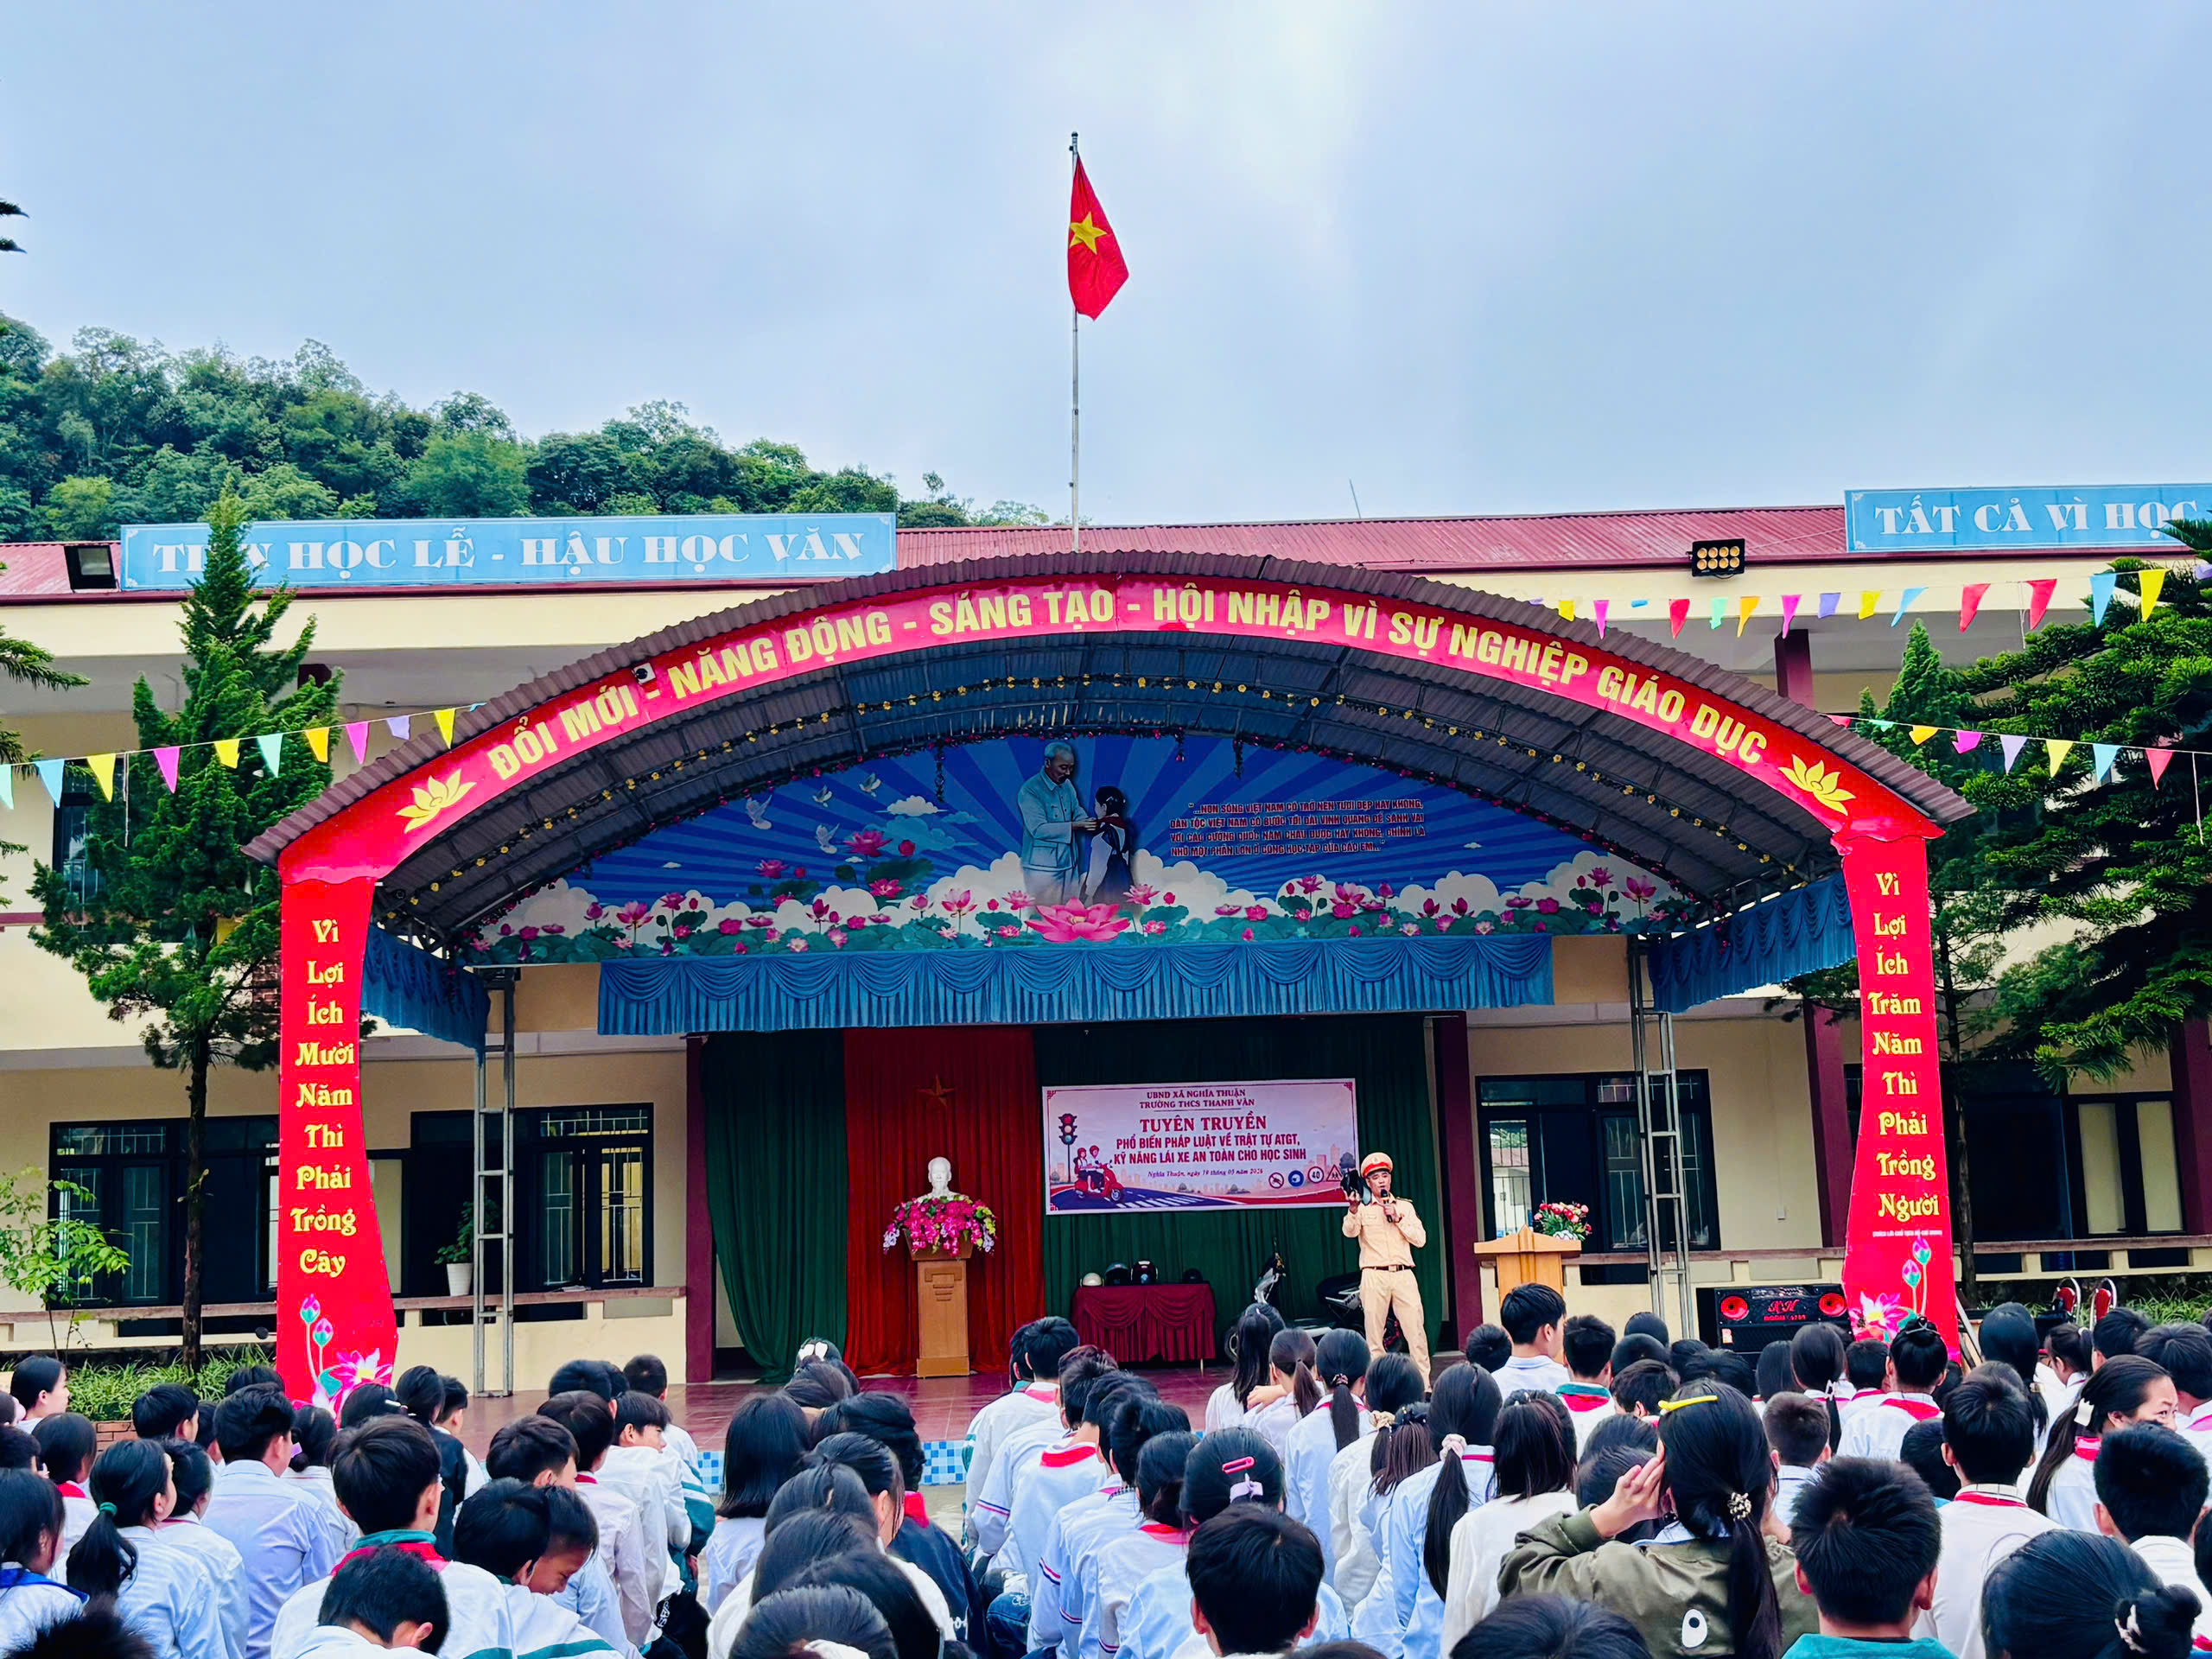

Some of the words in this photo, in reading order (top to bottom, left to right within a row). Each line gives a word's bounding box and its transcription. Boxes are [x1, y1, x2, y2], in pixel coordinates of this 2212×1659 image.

[1874, 494, 1961, 535] TẤT
[1974, 498, 2032, 532] CẢ
[2044, 496, 2090, 531] VÌ
[2103, 499, 2197, 540] HỌC
[152, 543, 273, 573] TIN
[287, 539, 397, 580] HỌC
[412, 526, 475, 569] LỄ
[519, 531, 629, 575] HẬU
[642, 533, 750, 574] HỌC
[764, 526, 865, 562] VĂN
[486, 715, 558, 780] ĐỔI
[560, 684, 639, 744] MỚI
[667, 646, 779, 700] NĂNG
[785, 611, 893, 663] ĐỘNG
[930, 593, 1033, 636] SÁNG
[1043, 589, 1115, 631] TẠO
[1153, 582, 1215, 629] HỘI
[1228, 589, 1330, 635] NHẬP
[1344, 594, 1378, 640] VÌ
[1388, 611, 1446, 656] SỰ
[1448, 622, 1590, 686] NGHIỆP
[1597, 665, 1686, 723] GIÁO
[1689, 704, 1768, 764] DỤC
[1264, 802, 1285, 812] NAM
[1228, 817, 1248, 827] NAM
[1874, 872, 1901, 896] Vì
[311, 918, 340, 944] Vì
[1873, 912, 1907, 940] Lợi
[1875, 944, 1909, 976] Ích
[306, 960, 345, 989] Lợi
[307, 994, 344, 1025] Ích
[1867, 991, 1922, 1015] Trăm
[295, 1041, 355, 1067] Mười
[1872, 1032, 1923, 1056] Năm
[296, 1083, 353, 1108] Năm
[1216, 1088, 1246, 1098] THUẬN
[1882, 1071, 1918, 1096] Thì
[1140, 1100, 1176, 1109] TRƯỜNG
[1203, 1099, 1235, 1108] THANH
[1140, 1115, 1195, 1133] TUYÊN
[1200, 1110, 1267, 1131] TRUYỀN
[1878, 1110, 1928, 1135] Phải
[304, 1123, 344, 1148] Thì
[1116, 1134, 1136, 1149] PHỔ
[1139, 1135, 1162, 1149] BIẾN
[1165, 1135, 1191, 1148] PHÁP
[1193, 1134, 1217, 1149] LUẬT
[1234, 1133, 1257, 1148] TRẬT
[1260, 1134, 1274, 1147] TỰ
[1274, 1133, 1300, 1146] ATGT,
[1160, 1150, 1174, 1163] LÁI
[1178, 1152, 1190, 1163] XE
[1192, 1151, 1206, 1162] AN
[1210, 1148, 1235, 1162] TOÀN
[1237, 1149, 1257, 1161] CHO
[1261, 1148, 1281, 1162] HỌC
[1283, 1148, 1306, 1160] SINH
[1876, 1148, 1936, 1181] Trồng
[296, 1164, 351, 1190] Phải
[1312, 1171, 1320, 1179] 40
[290, 1204, 357, 1236] Trồng
[1878, 1192, 1940, 1223] Người
[299, 1249, 346, 1278] Cây
